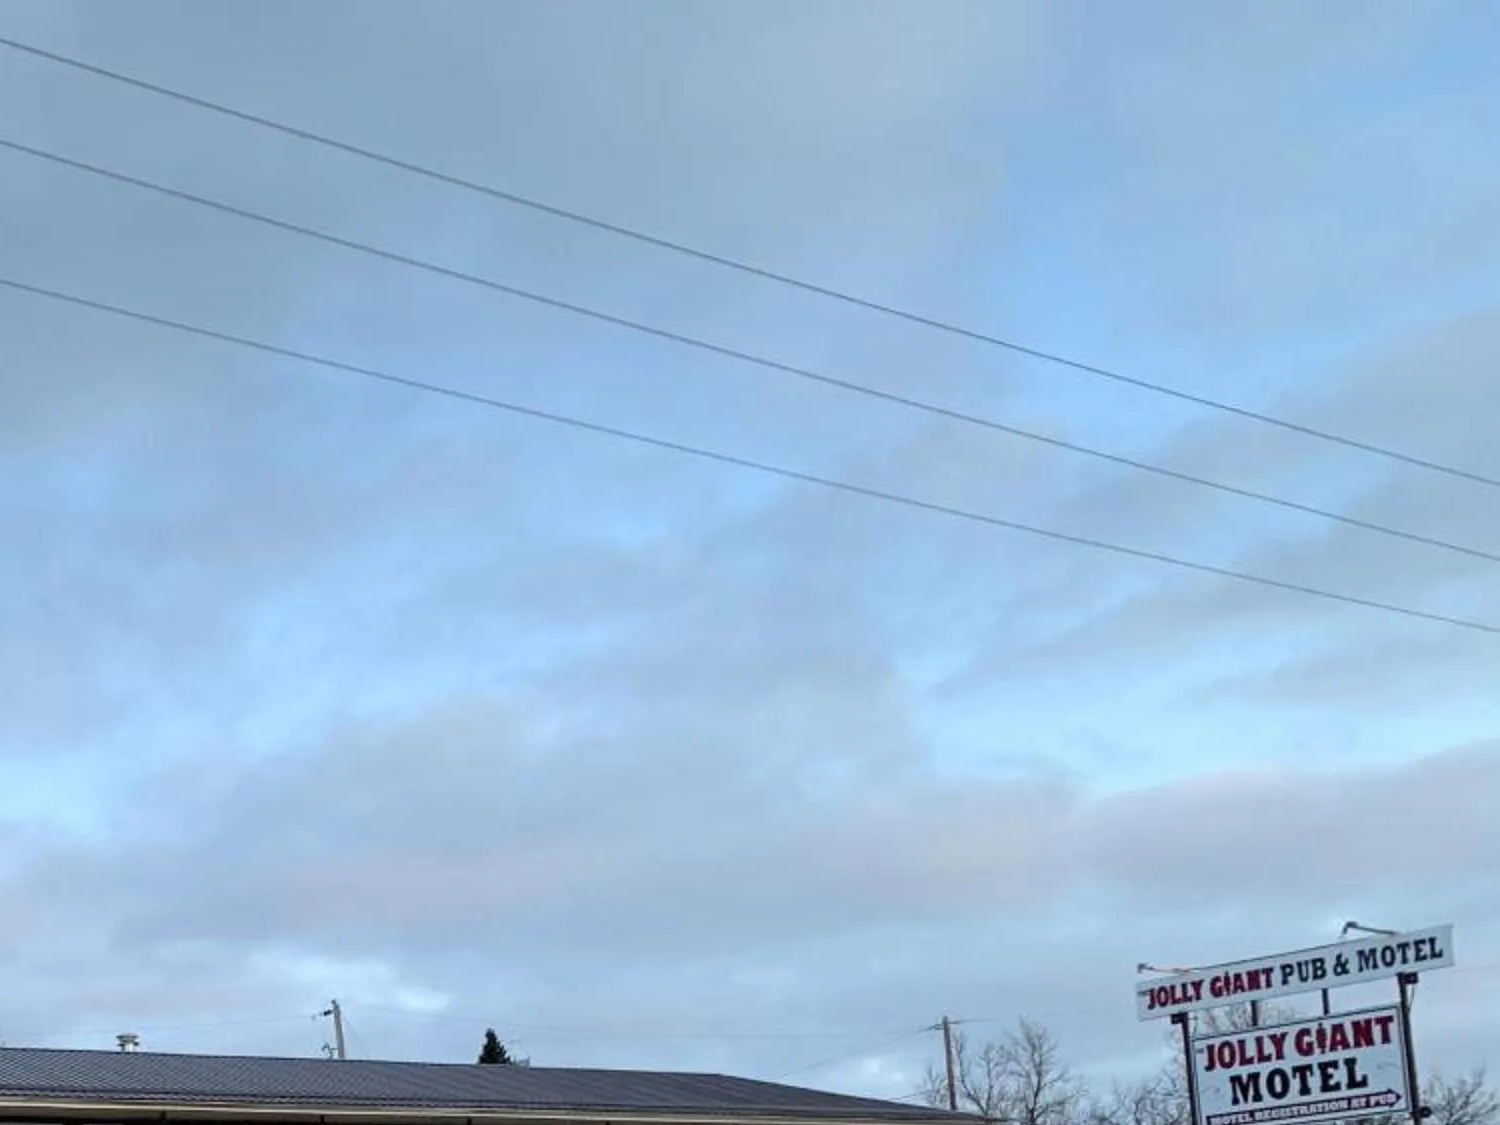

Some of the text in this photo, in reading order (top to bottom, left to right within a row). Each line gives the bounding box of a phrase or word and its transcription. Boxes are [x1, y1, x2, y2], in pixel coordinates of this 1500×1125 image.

[1148, 937, 1443, 1010] JOLLY GIANT PUB & MOTEL
[1204, 1015, 1394, 1072] JOLLY GIANT
[1229, 1057, 1368, 1106] MOTEL
[1210, 1094, 1396, 1125] MOTEL REGISTRATION AT PUB
